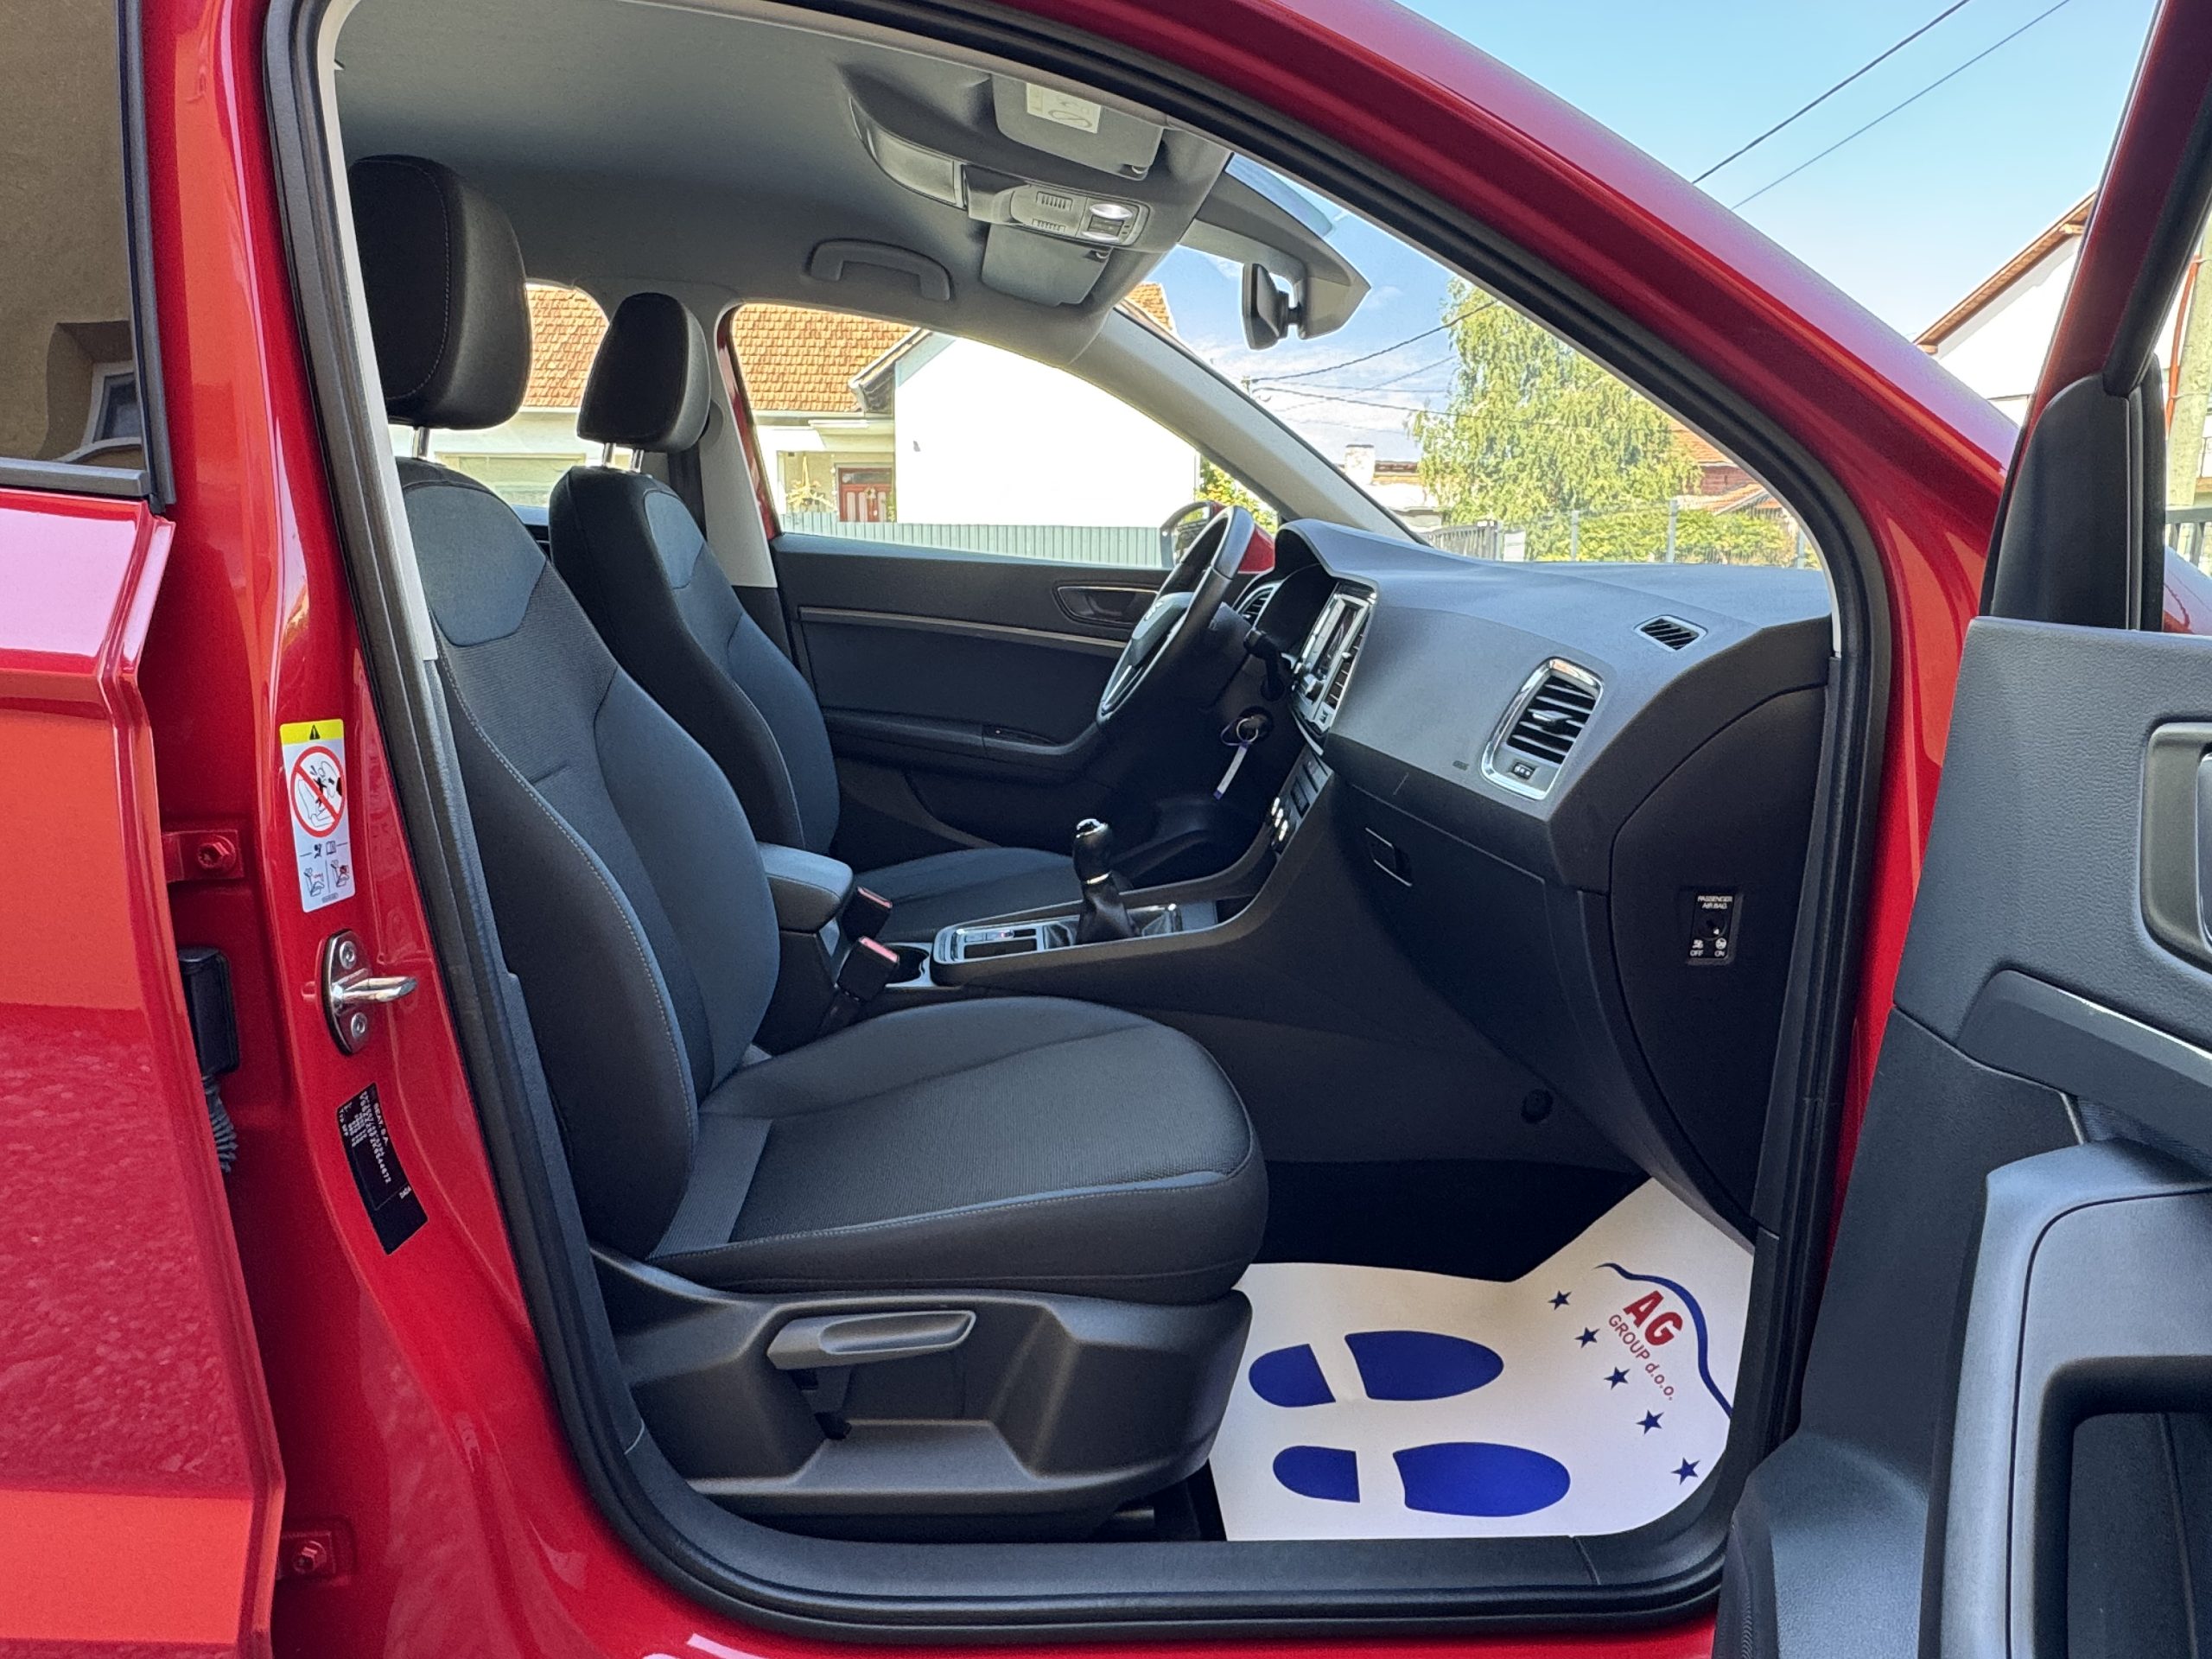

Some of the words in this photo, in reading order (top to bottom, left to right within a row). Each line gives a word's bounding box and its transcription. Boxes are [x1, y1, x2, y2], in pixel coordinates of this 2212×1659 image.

[1623, 1290, 1683, 1346] AG
[1608, 1314, 1651, 1360] GROUP
[1644, 1363, 1675, 1402] d.o.o.
